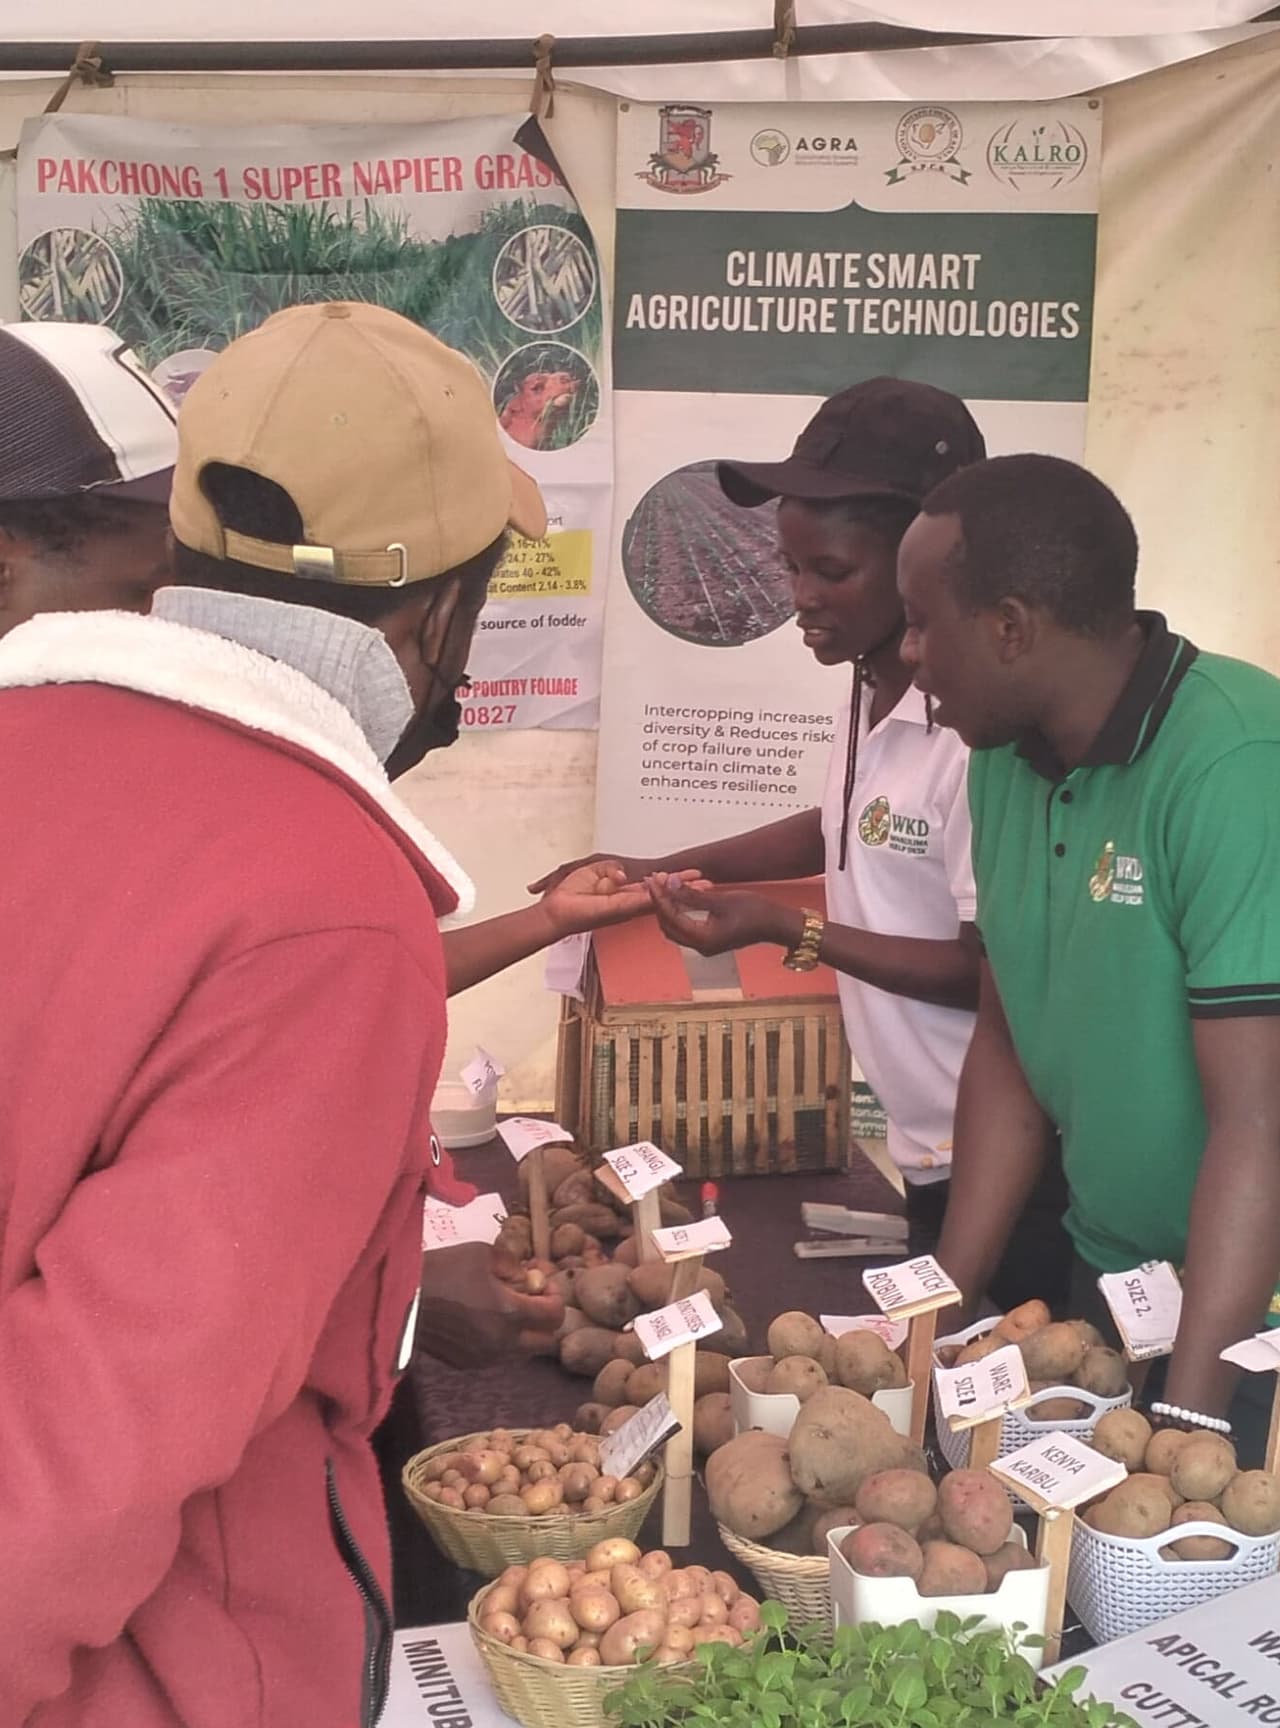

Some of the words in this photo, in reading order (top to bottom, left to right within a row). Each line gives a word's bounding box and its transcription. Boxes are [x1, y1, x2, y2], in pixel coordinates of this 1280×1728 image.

[795, 137, 859, 152] AGRA
[994, 143, 1081, 163] KALRO
[36, 157, 203, 199] PAKCHONG
[215, 167, 230, 198] 1
[243, 163, 343, 200] SUPER
[352, 155, 463, 195] NAPIER
[475, 152, 566, 190] GRAS
[726, 250, 861, 288] CLIMATE
[866, 252, 981, 290] SMART
[625, 294, 837, 333] AGRICULTURE
[844, 298, 1080, 338] TECHNOLOGIES
[500, 582, 537, 593] Content
[480, 618, 527, 631] source
[531, 615, 544, 628] of
[548, 614, 587, 628] fodder
[473, 678, 528, 698] POULTRY
[531, 677, 578, 696] FOLIAGE
[460, 705, 517, 726] 0827
[644, 704, 754, 723] Intercropping
[758, 709, 833, 725] increases
[643, 722, 711, 739] diversity
[714, 726, 725, 738] &
[730, 726, 799, 741] Reduces
[802, 730, 836, 743] risks
[642, 739, 658, 752] of
[662, 743, 698, 756] crop
[702, 742, 752, 757] failure
[756, 746, 805, 760] under
[642, 759, 719, 773] uncertain
[722, 761, 783, 776] climate
[786, 765, 797, 776] &
[641, 776, 718, 790] enhances
[721, 779, 798, 794] resilience
[891, 814, 929, 837] WKD
[611, 1155, 632, 1177] SIZE
[908, 1259, 950, 1294] DUTCH
[1124, 1278, 1148, 1305] SIZE
[954, 1375, 976, 1399] SIZE
[988, 1361, 1013, 1396] WARE
[1040, 1445, 1086, 1475] KENYA
[1008, 1459, 1061, 1494] KARIBU.
[1146, 1633, 1248, 1700] APICAL
[1119, 1682, 1210, 1728] CUTT
